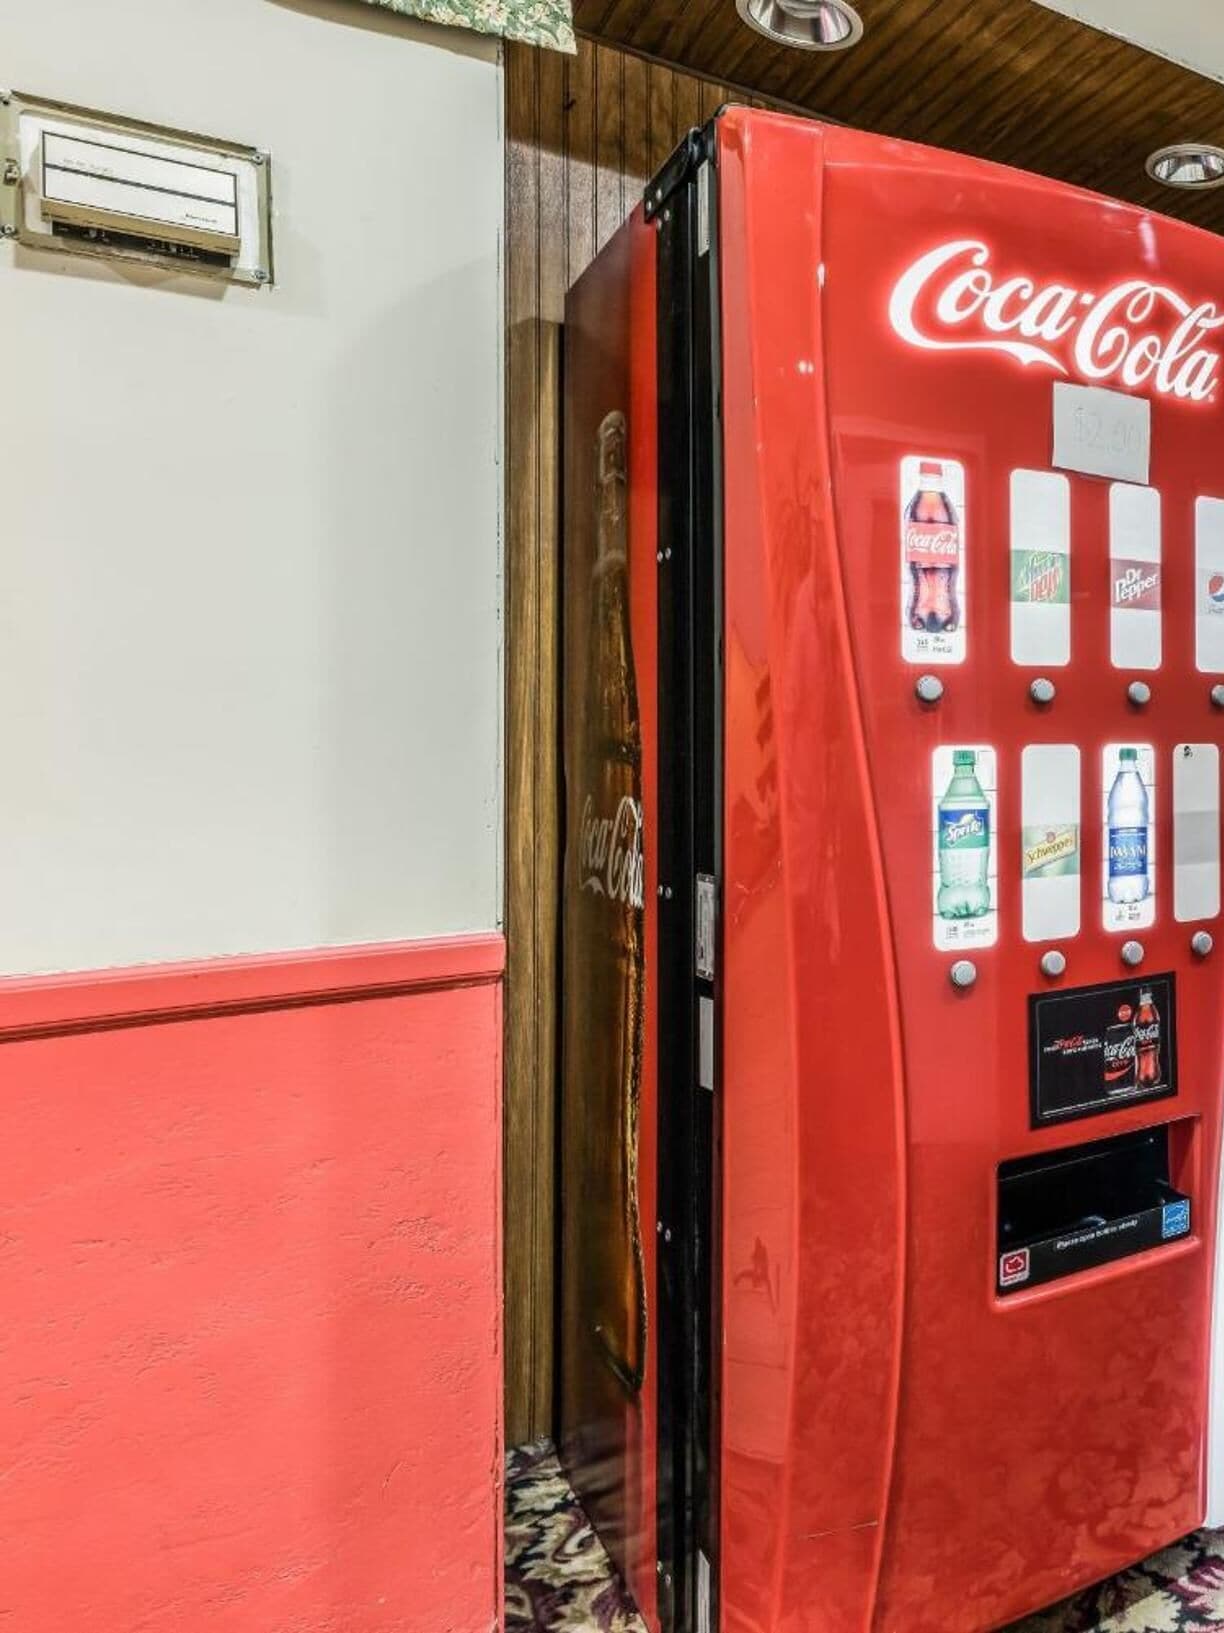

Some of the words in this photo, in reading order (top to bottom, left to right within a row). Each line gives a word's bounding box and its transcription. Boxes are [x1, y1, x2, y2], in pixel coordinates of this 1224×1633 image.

[1125, 568, 1142, 581] Dr
[1114, 574, 1159, 603] Pepper
[945, 819, 981, 844] Sprite
